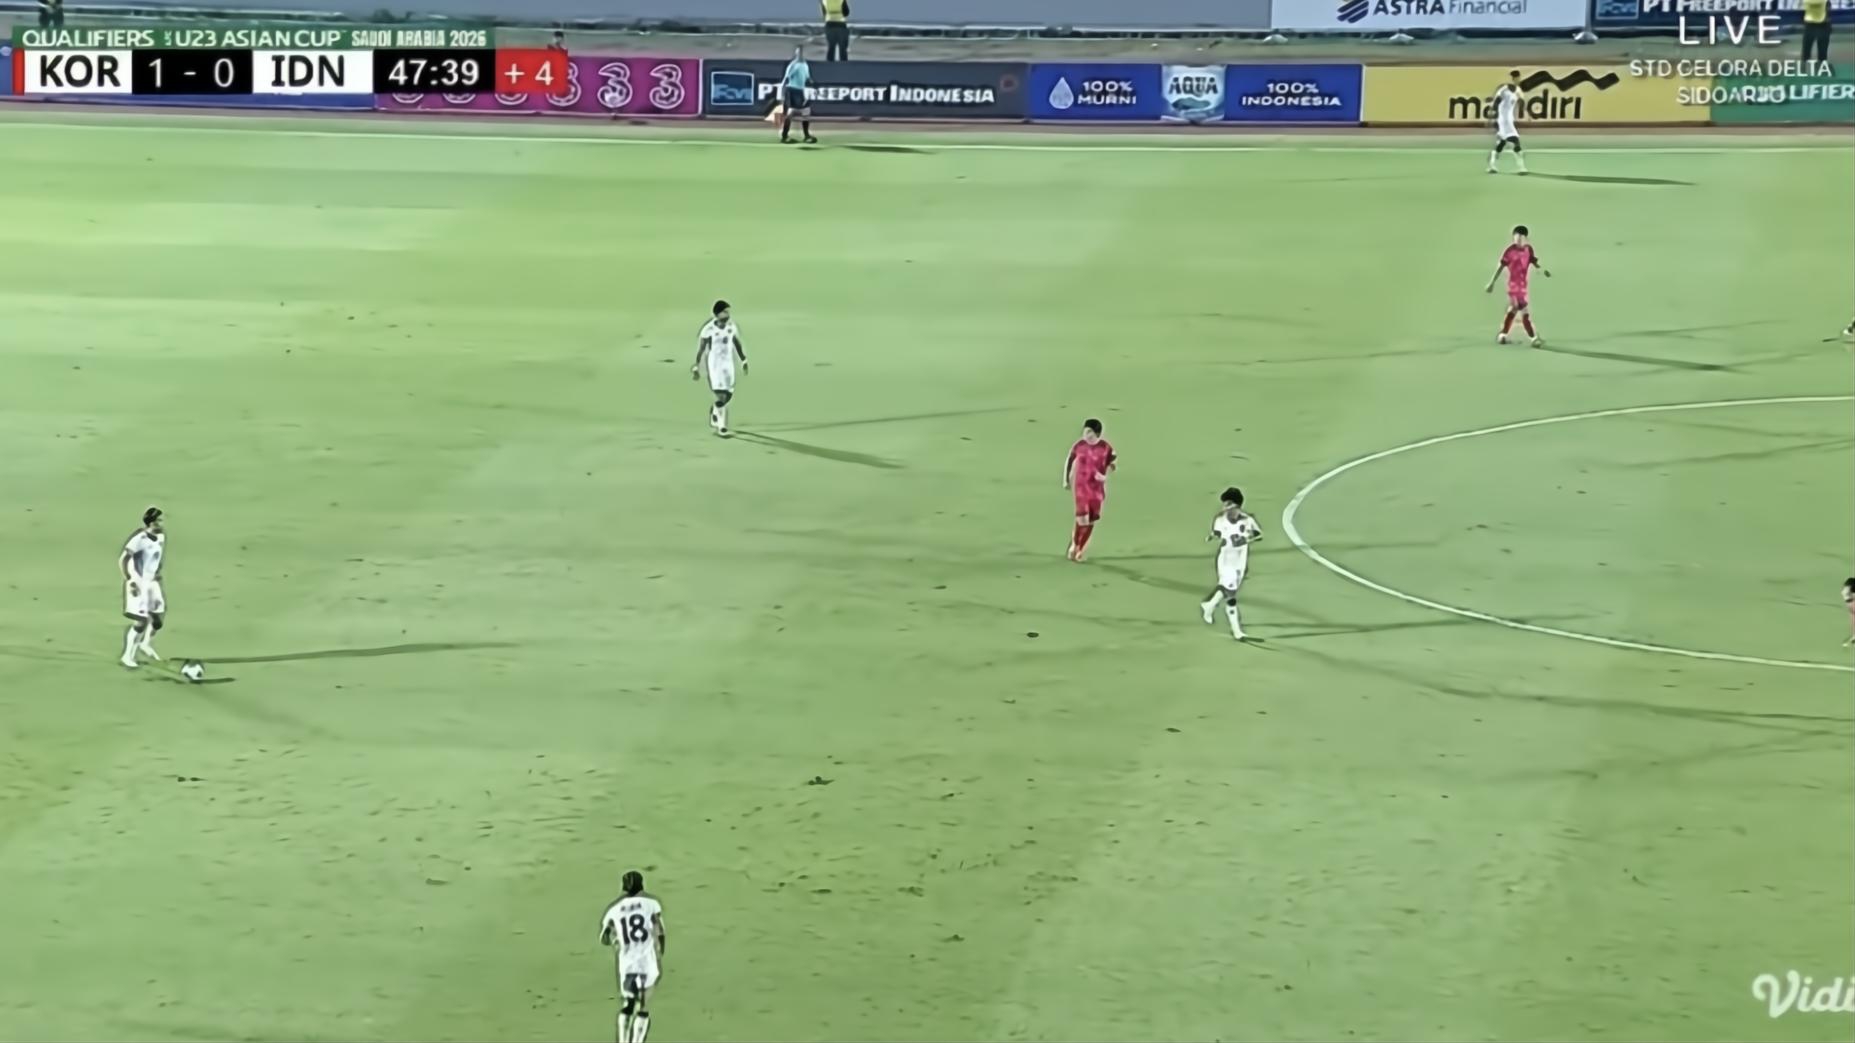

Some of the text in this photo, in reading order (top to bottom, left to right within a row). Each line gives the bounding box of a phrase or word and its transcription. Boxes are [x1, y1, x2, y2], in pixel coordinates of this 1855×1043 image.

[1373, 0, 1528, 15] ASTRA Financial
[1082, 80, 1134, 92] 100%
[1168, 76, 1218, 98] AQUA
[1266, 82, 1320, 94] 100%
[803, 86, 888, 101] REEPORT
[889, 84, 995, 103] INDONESIA
[1077, 94, 1137, 105] MURNI
[1241, 95, 1342, 106] INDONESIA
[620, 913, 649, 945] 18
